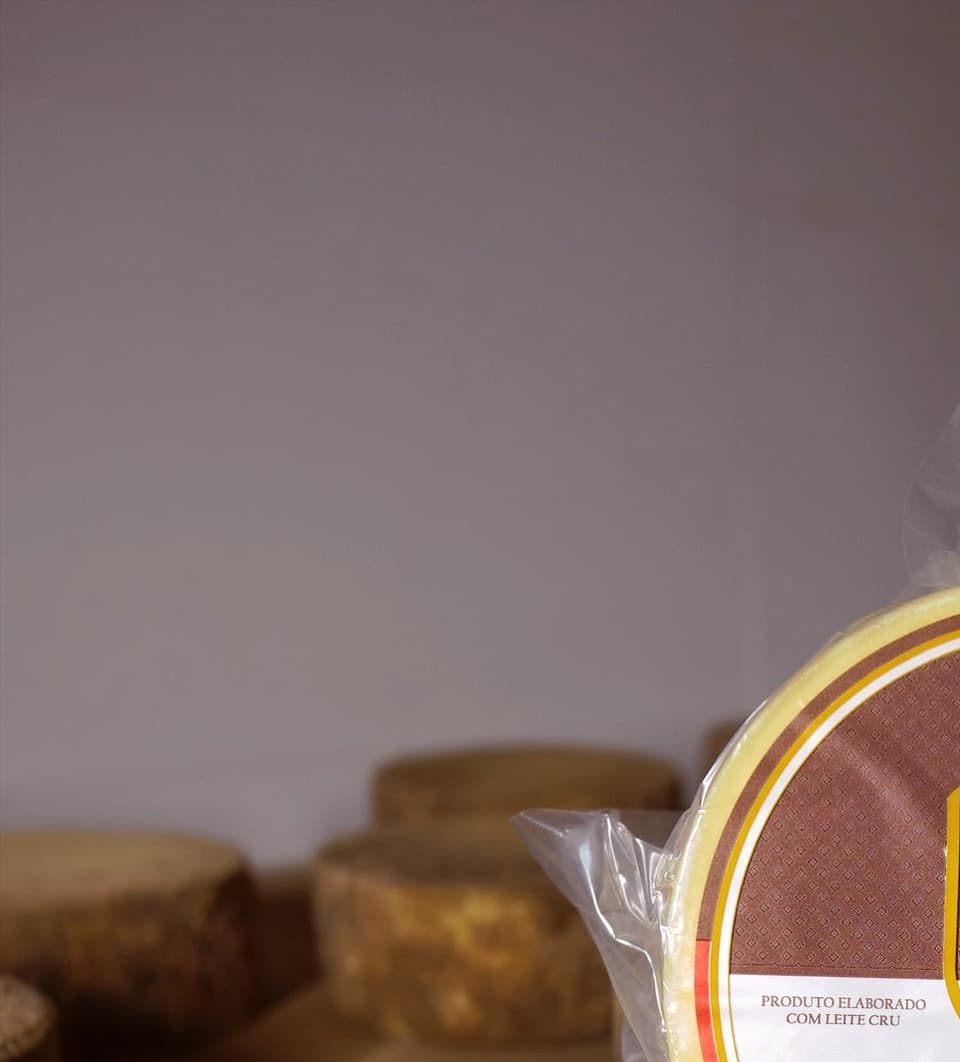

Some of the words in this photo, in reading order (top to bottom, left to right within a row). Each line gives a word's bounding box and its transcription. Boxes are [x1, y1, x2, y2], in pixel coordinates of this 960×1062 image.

[761, 995, 834, 1009] PRODUTO
[838, 997, 927, 1011] ELABORADO
[786, 1012, 821, 1025] COM
[825, 1013, 865, 1026] LEITE
[868, 1014, 901, 1027] CRU
